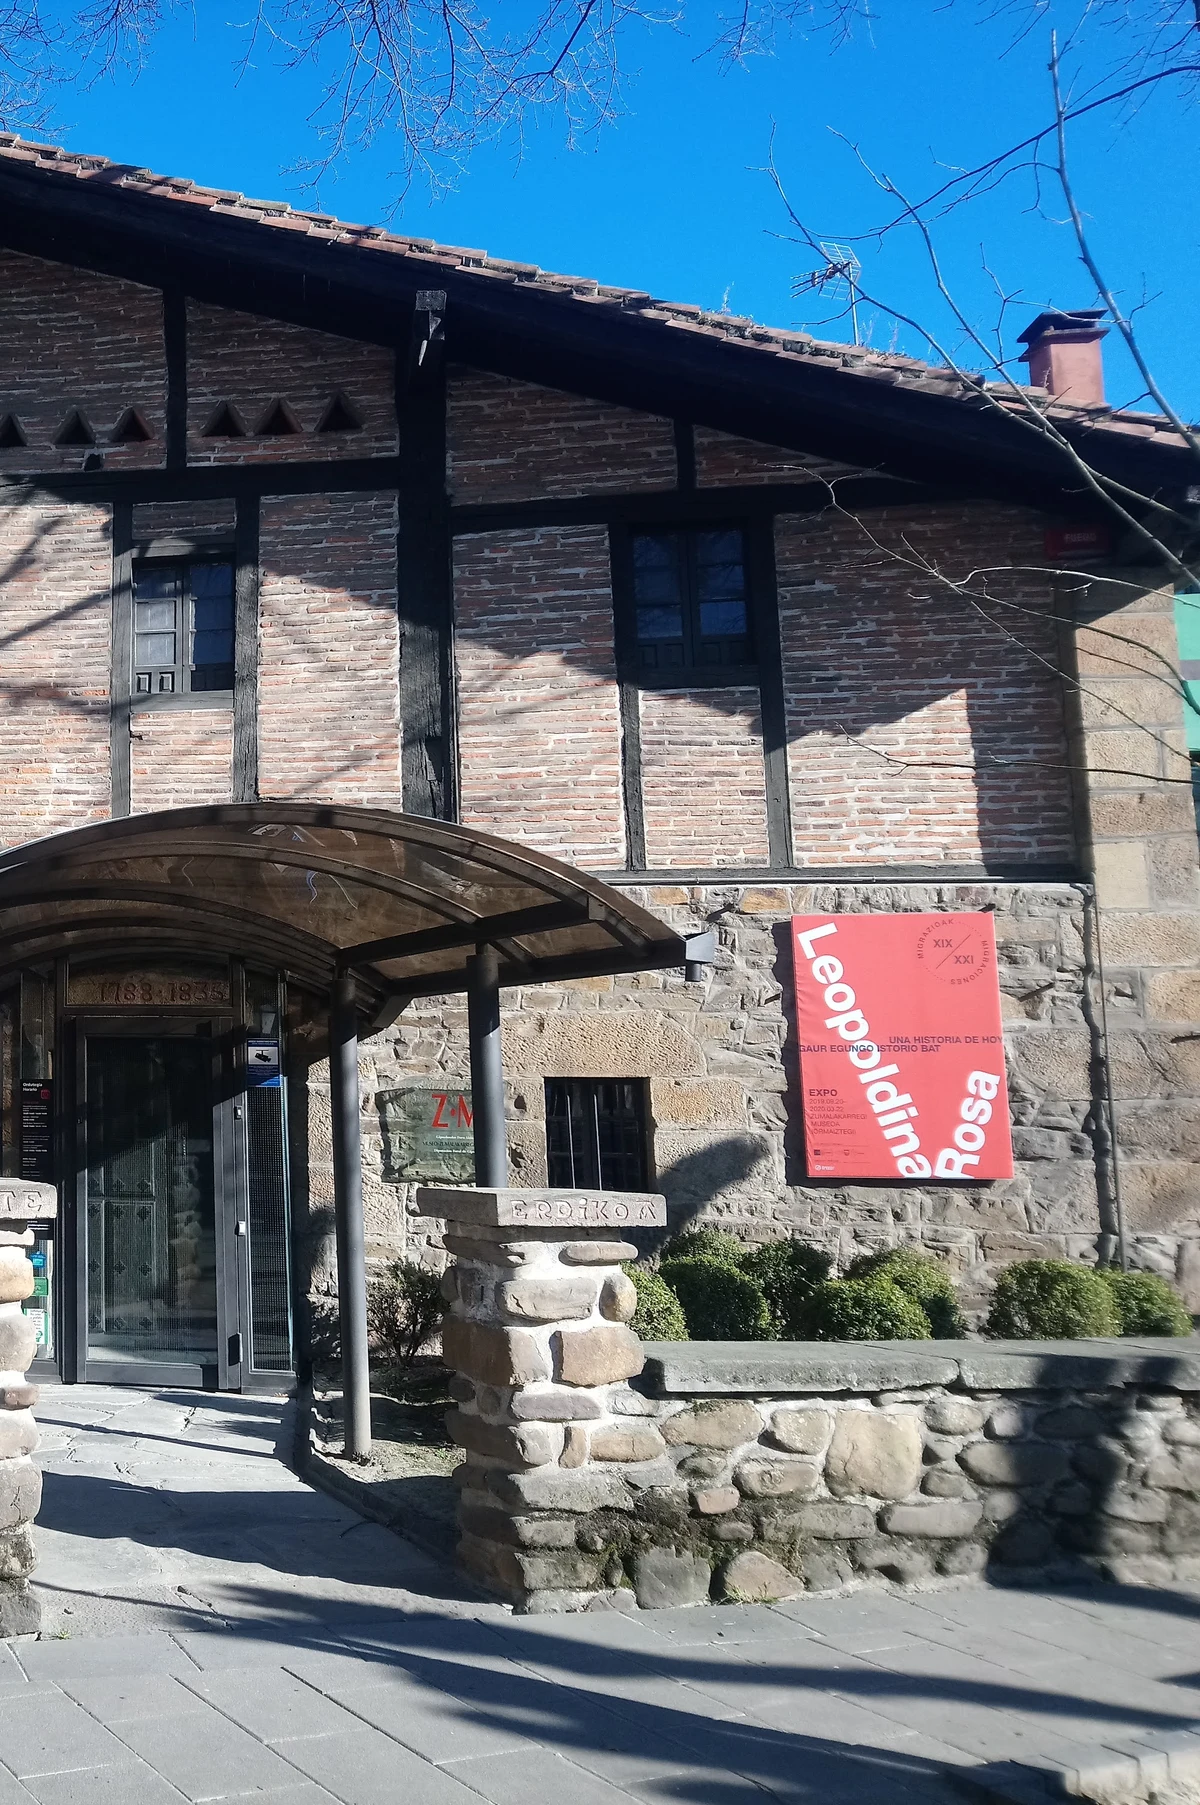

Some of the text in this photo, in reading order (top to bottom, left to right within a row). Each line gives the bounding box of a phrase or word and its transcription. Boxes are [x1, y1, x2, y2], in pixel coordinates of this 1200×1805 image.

[917, 919, 954, 959] MIGRAZIOAK
[933, 939, 953, 948] XIX
[950, 940, 990, 985] MIGRACIONES
[954, 955, 974, 964] XXI
[889, 1036, 1003, 1044] UNA HISTORIA DE HOY
[797, 922, 932, 1178] Leopoldina
[800, 1044, 941, 1052] GAUR EGUNGO ISTORIO BAT
[809, 1089, 838, 1097] EXPO
[934, 1070, 1000, 1178] Rosa
